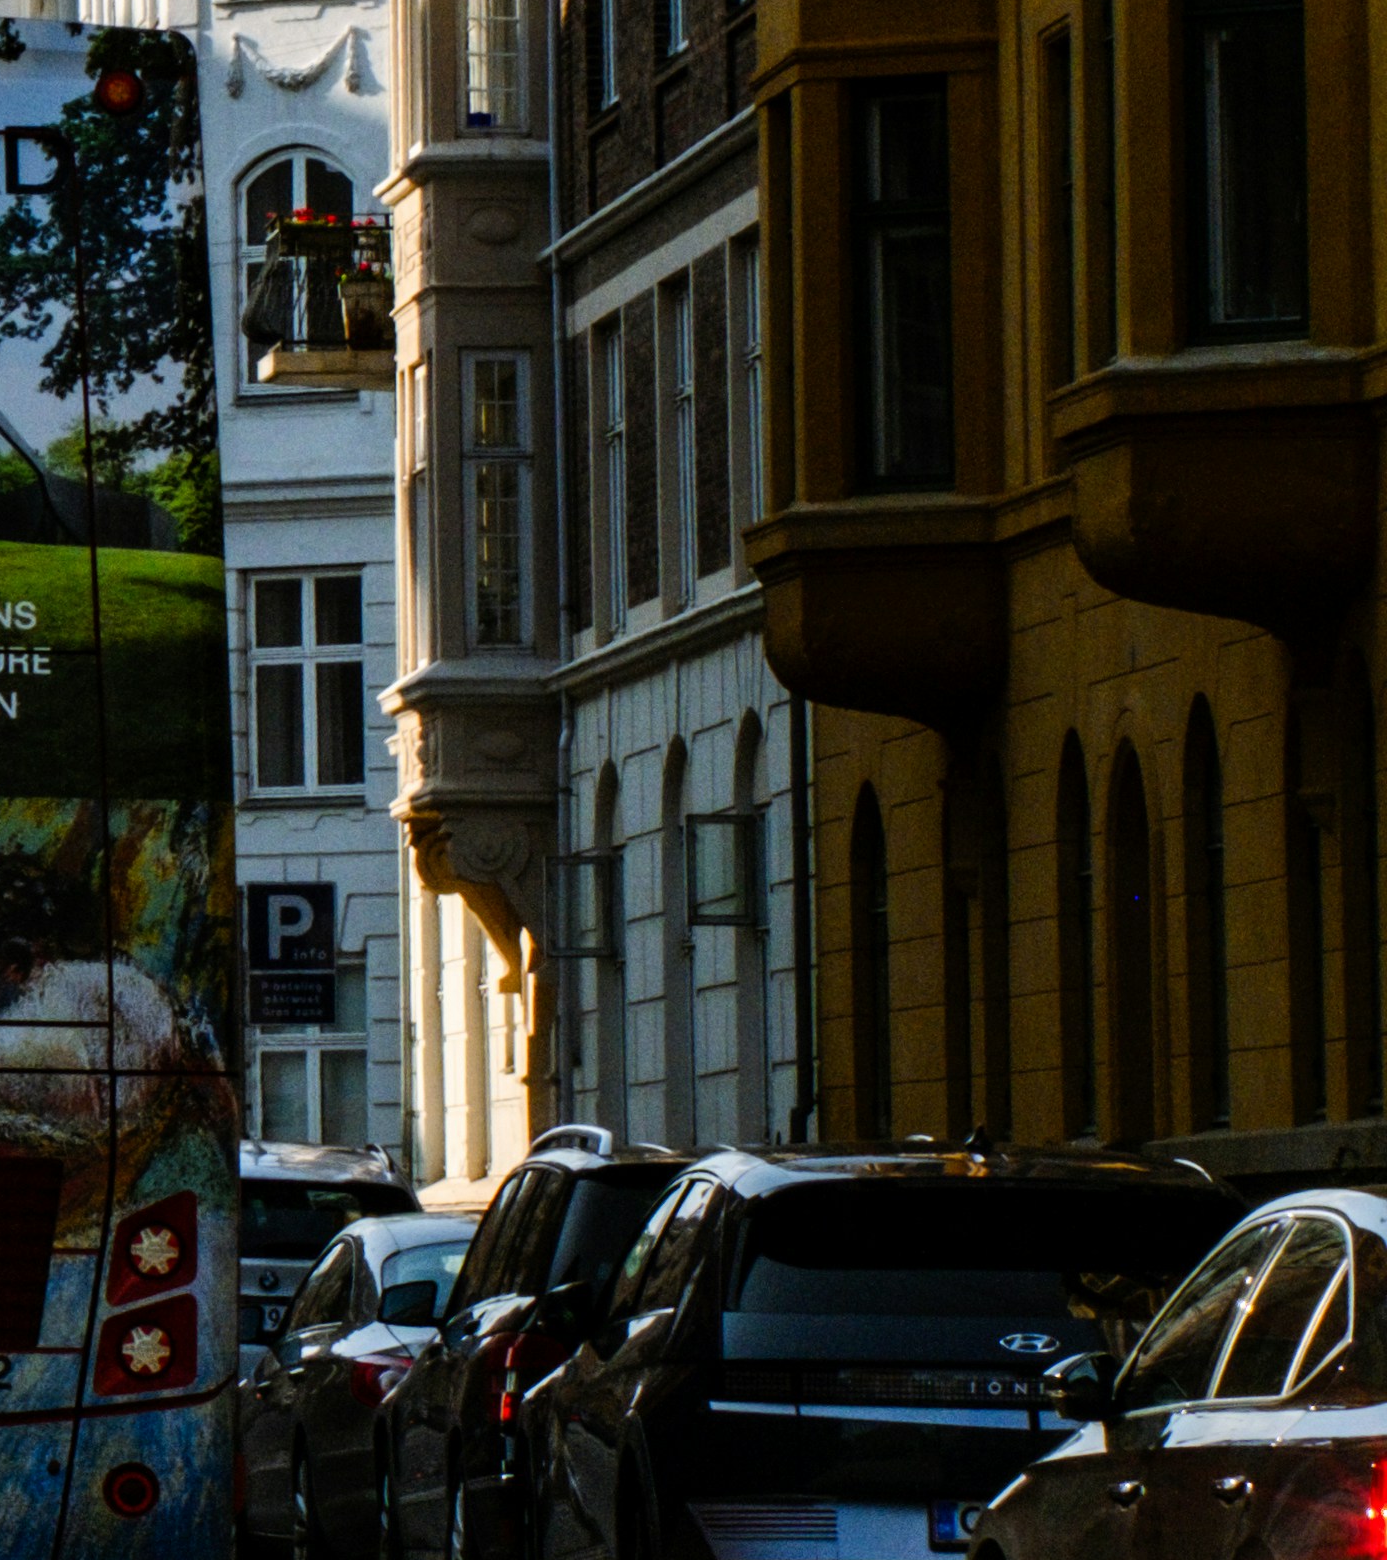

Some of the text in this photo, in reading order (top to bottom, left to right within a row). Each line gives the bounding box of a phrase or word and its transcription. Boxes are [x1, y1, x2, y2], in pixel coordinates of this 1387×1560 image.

[267, 894, 315, 961] P
[292, 947, 327, 960] info
[970, 1381, 1046, 1395] IONI
